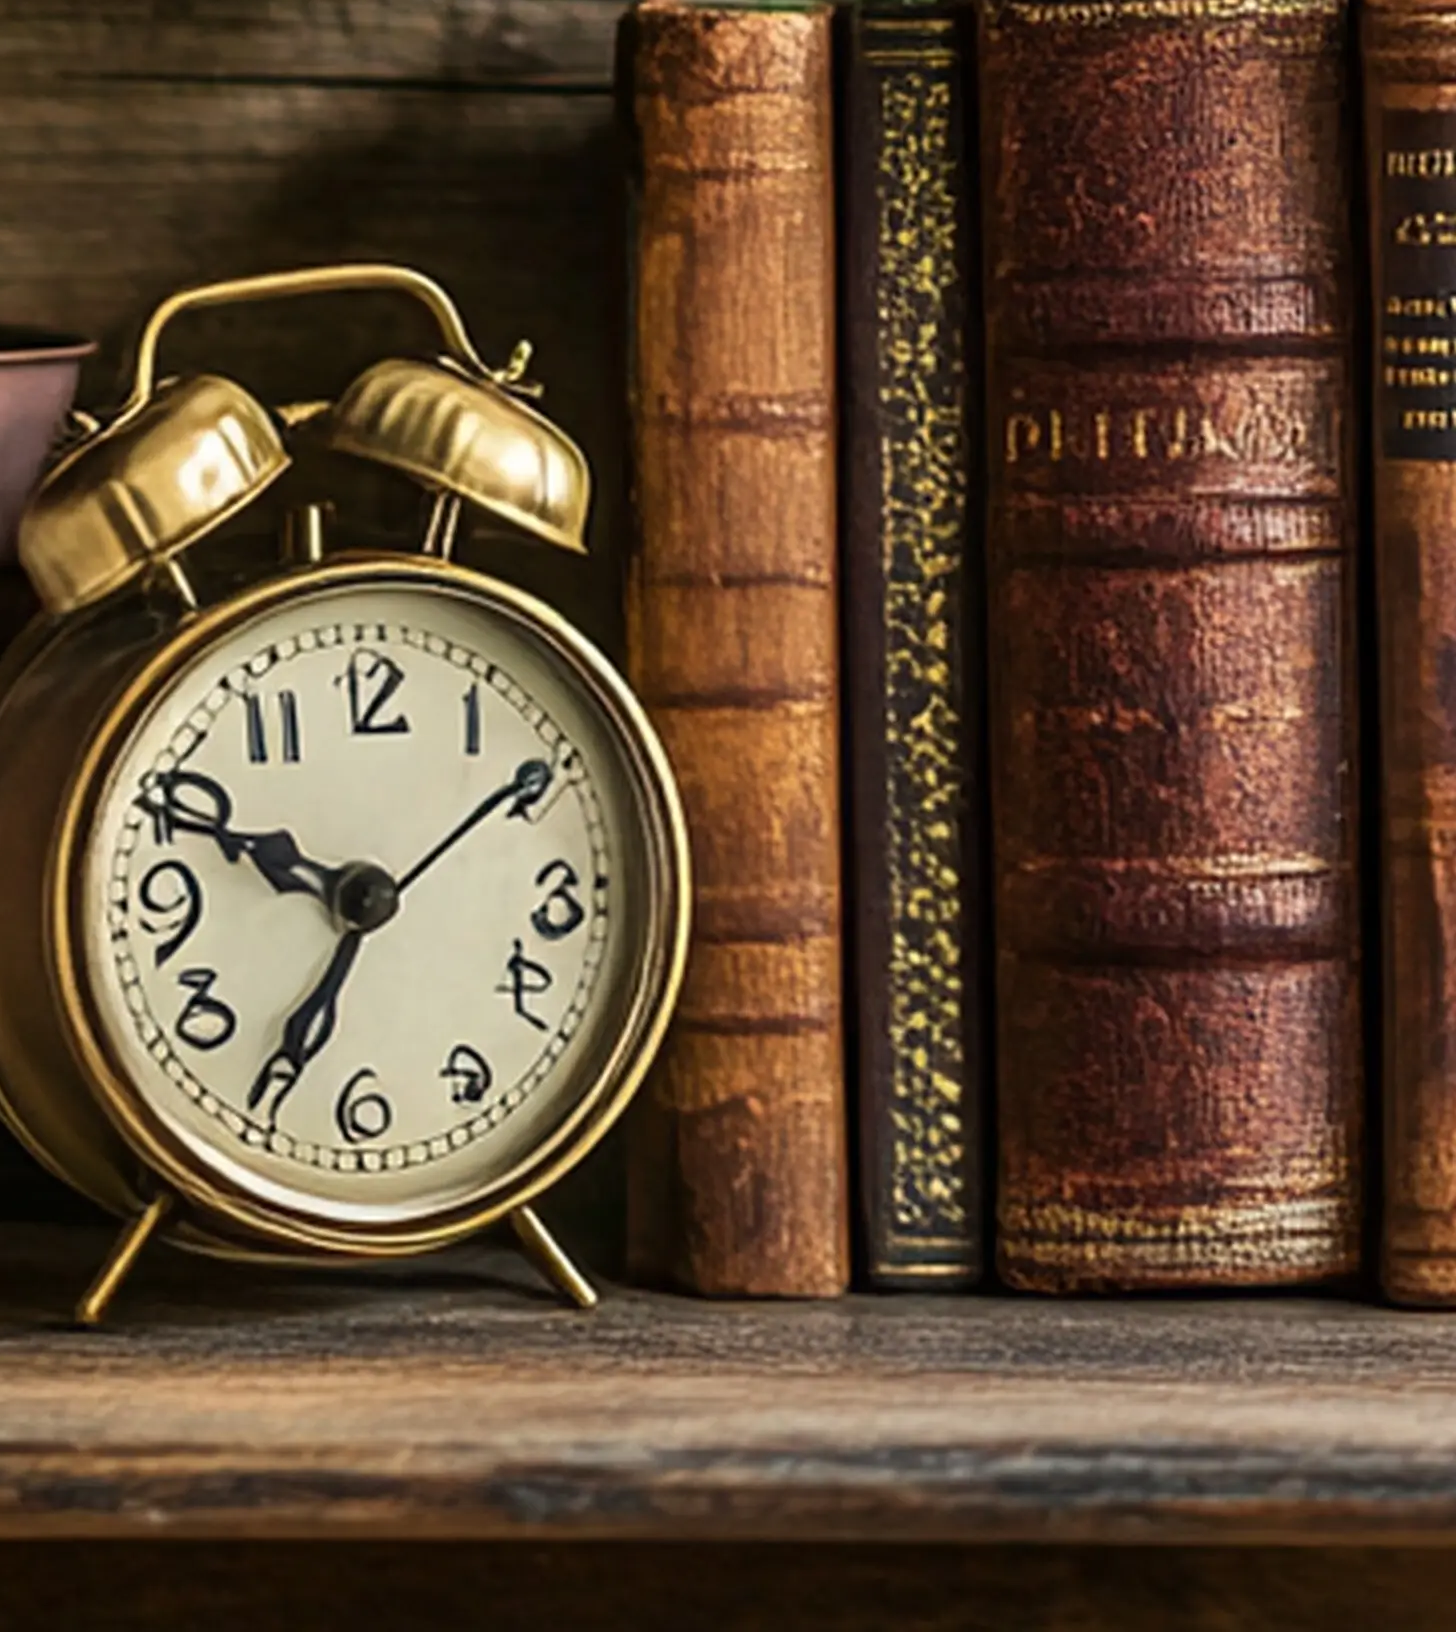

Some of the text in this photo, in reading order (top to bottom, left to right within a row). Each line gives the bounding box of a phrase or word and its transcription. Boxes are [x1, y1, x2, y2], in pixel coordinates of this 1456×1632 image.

[463, 683, 481, 756] 1
[139, 860, 203, 968] 9
[335, 1068, 392, 1145] 6
